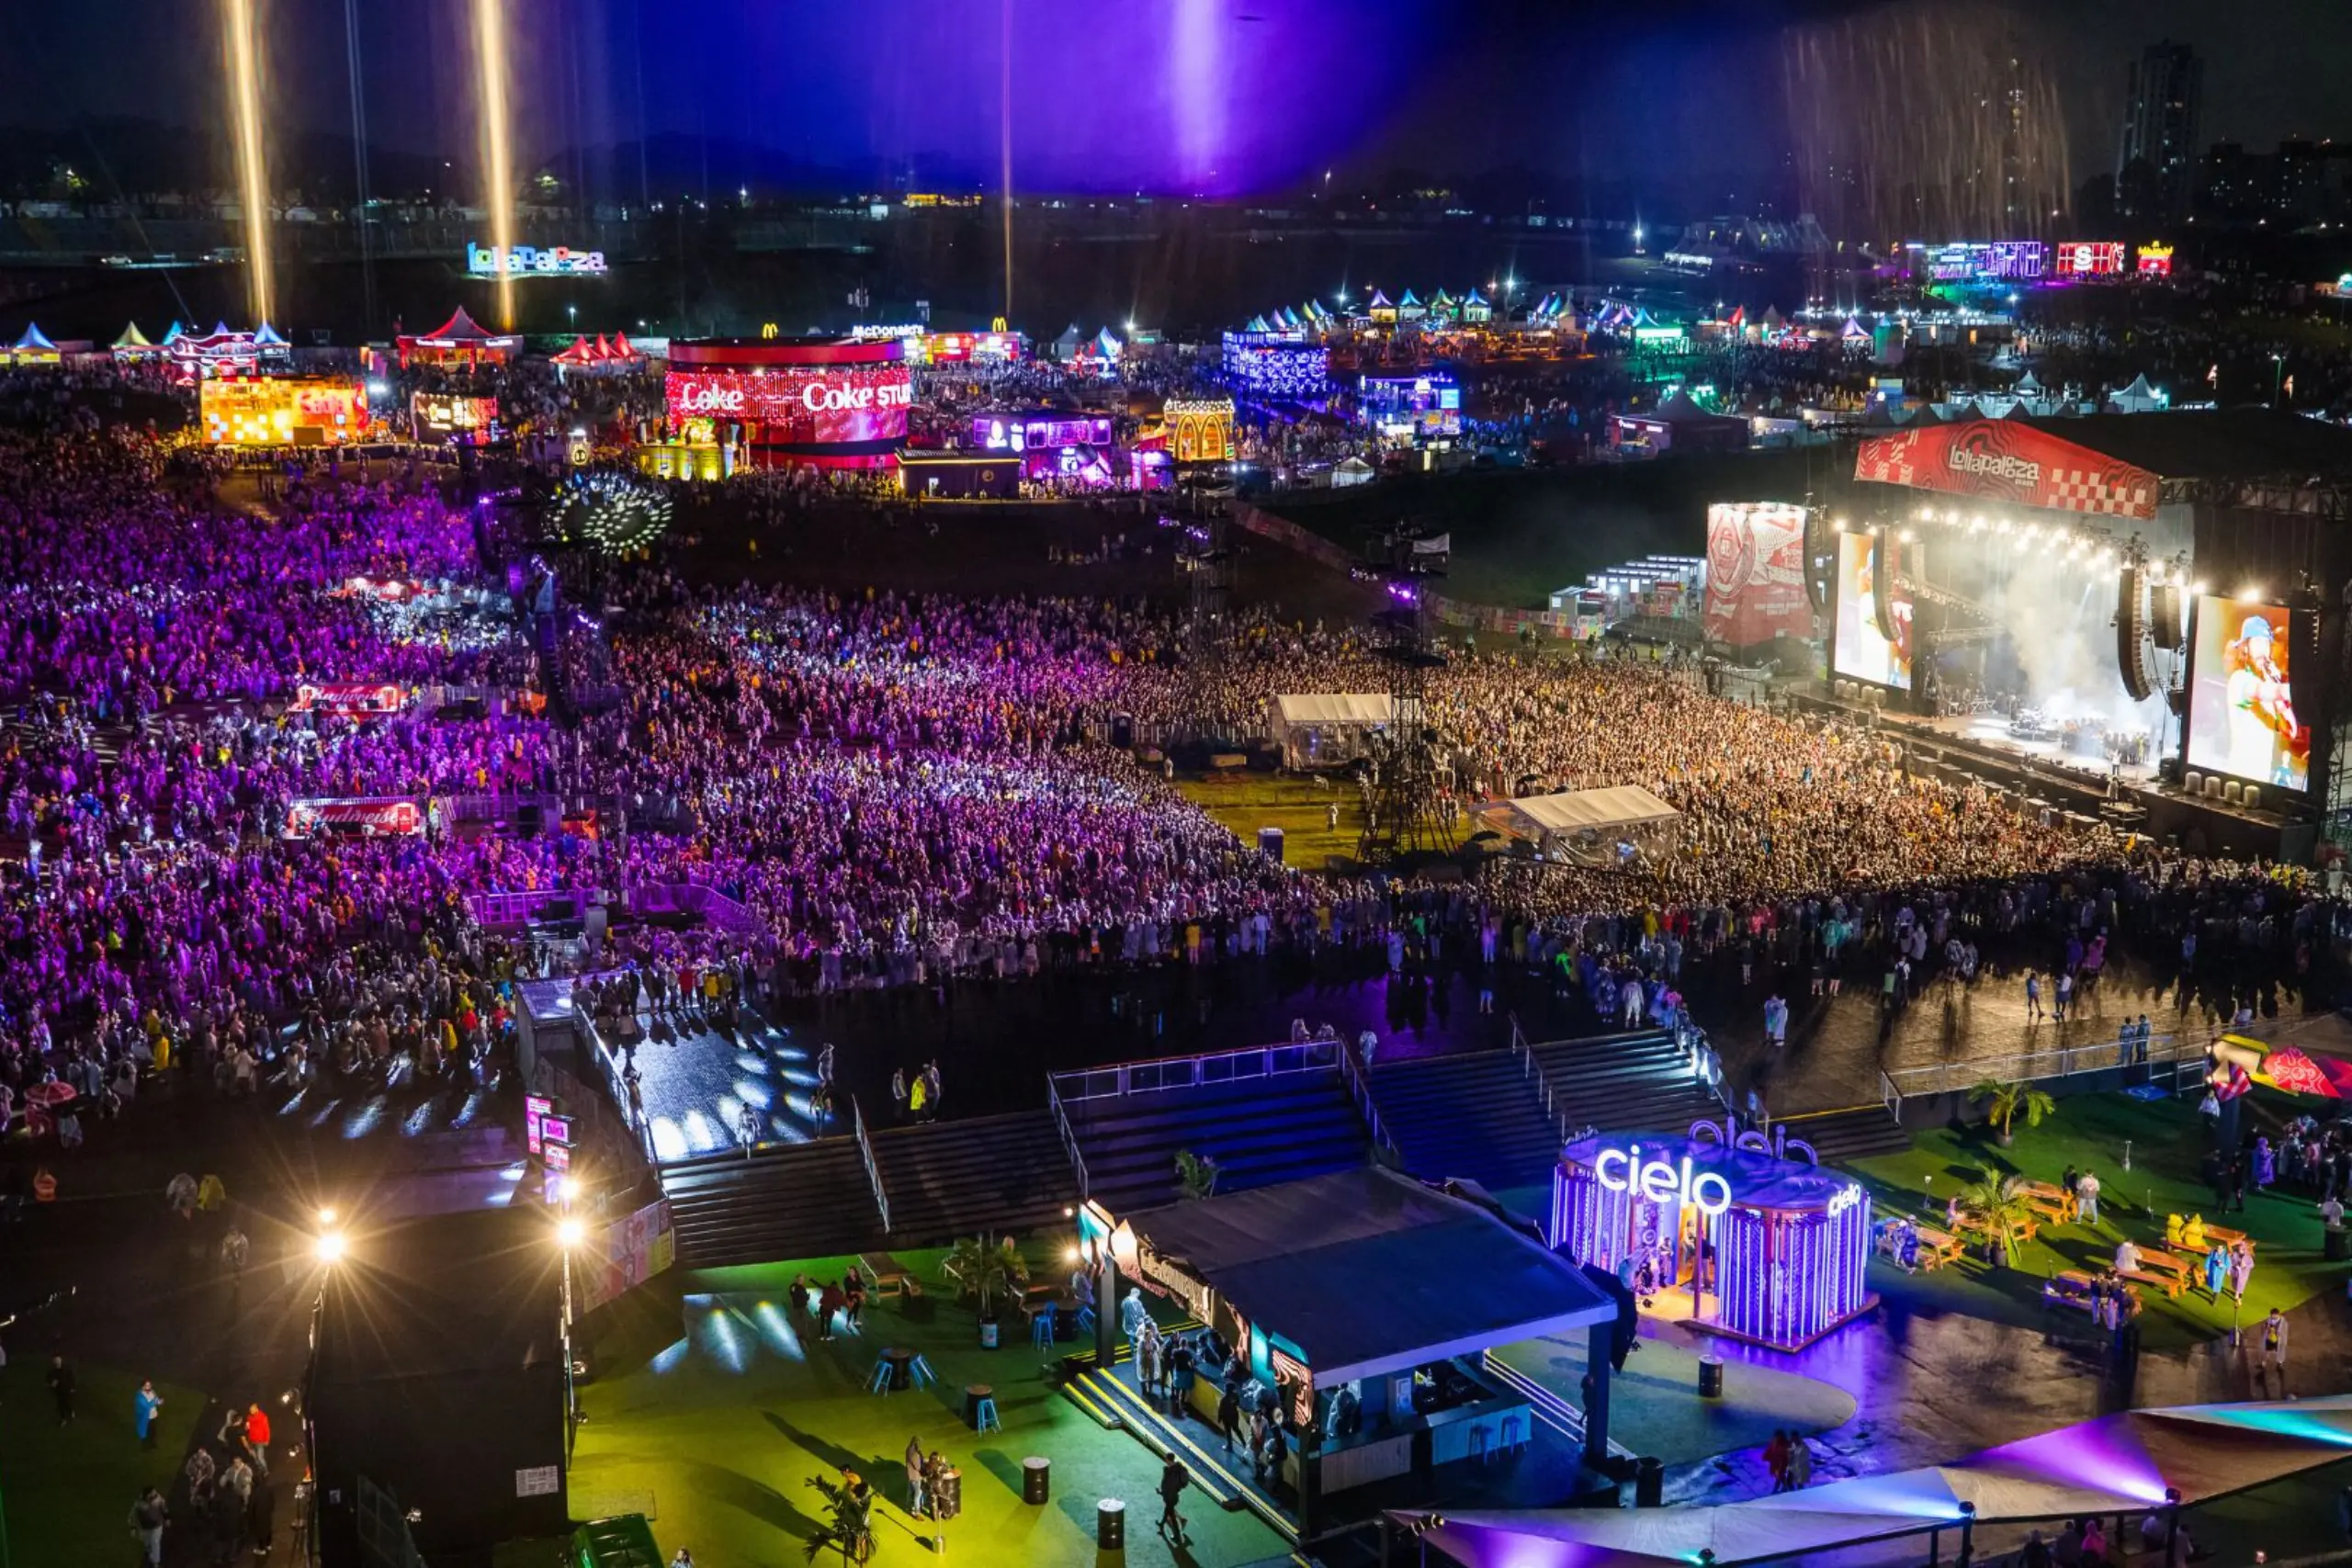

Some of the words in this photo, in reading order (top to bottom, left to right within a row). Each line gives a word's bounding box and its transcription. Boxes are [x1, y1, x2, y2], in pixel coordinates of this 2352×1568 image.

[682, 382, 745, 411] Coke
[802, 382, 874, 411] Coke
[1595, 1145, 1732, 1214] cielo
[1828, 1183, 1861, 1217] cielo
